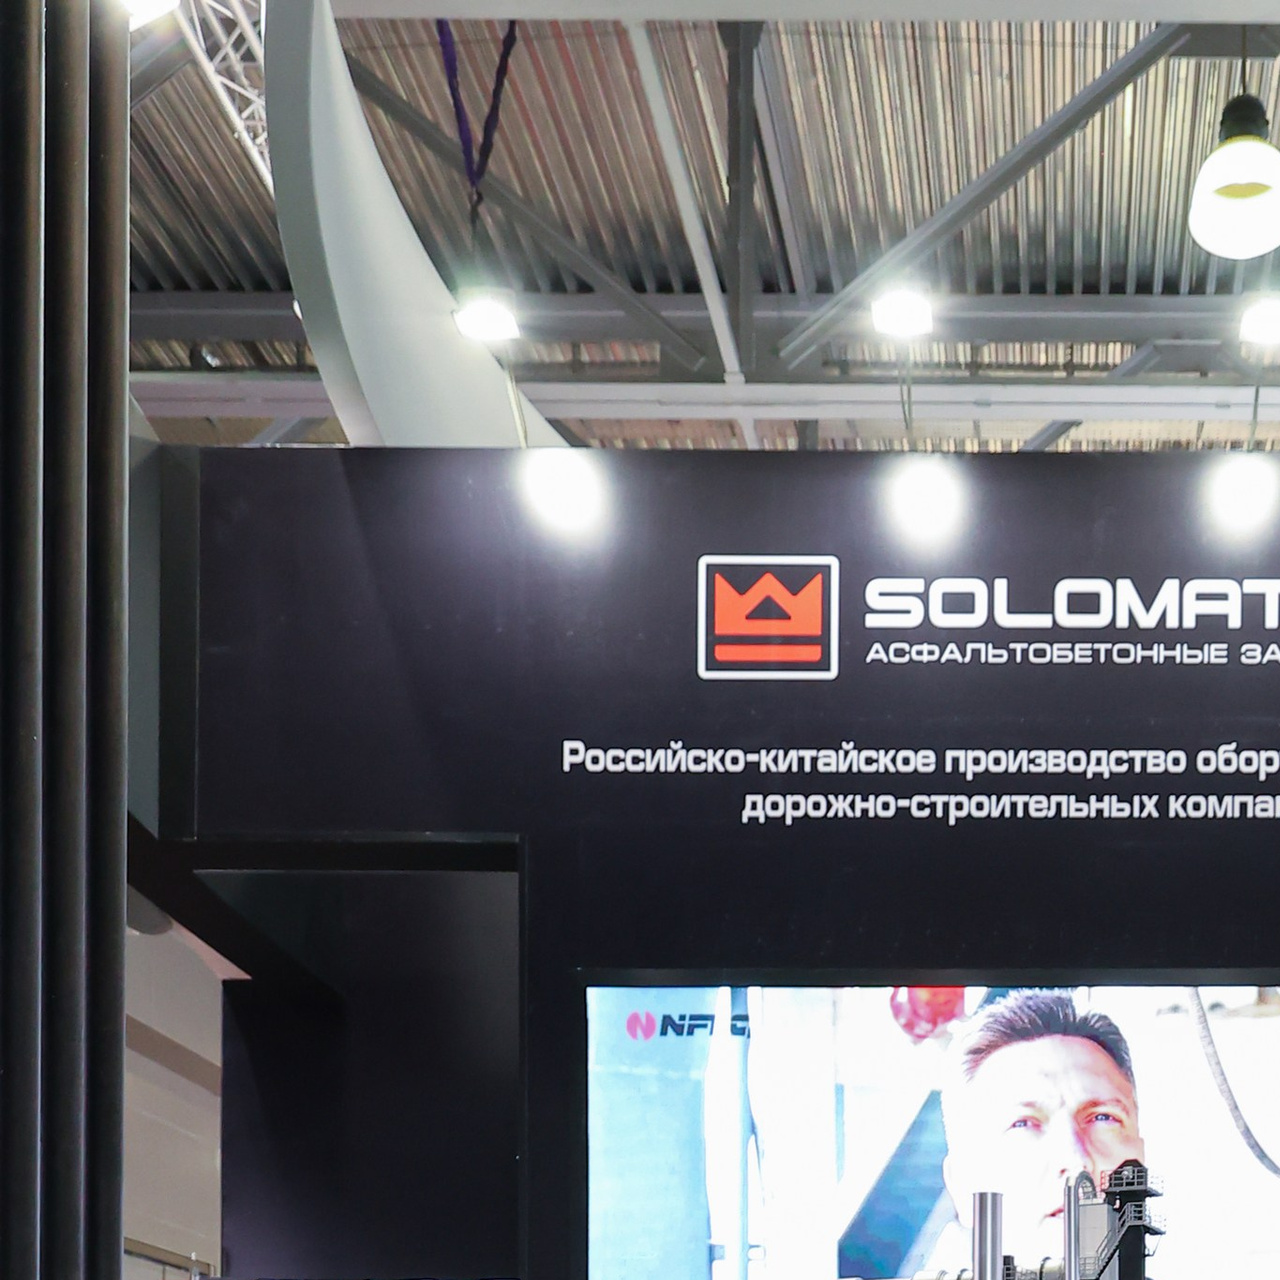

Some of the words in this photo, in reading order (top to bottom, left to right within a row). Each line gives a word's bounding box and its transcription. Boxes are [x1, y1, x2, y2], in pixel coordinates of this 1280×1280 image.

[866, 642, 1229, 666] АСФАЛЬТОБЕТОННЫЕ
[562, 740, 937, 773] Российско-китайское
[945, 749, 1187, 781] производство
[741, 794, 1160, 826] дорожно-строительных
